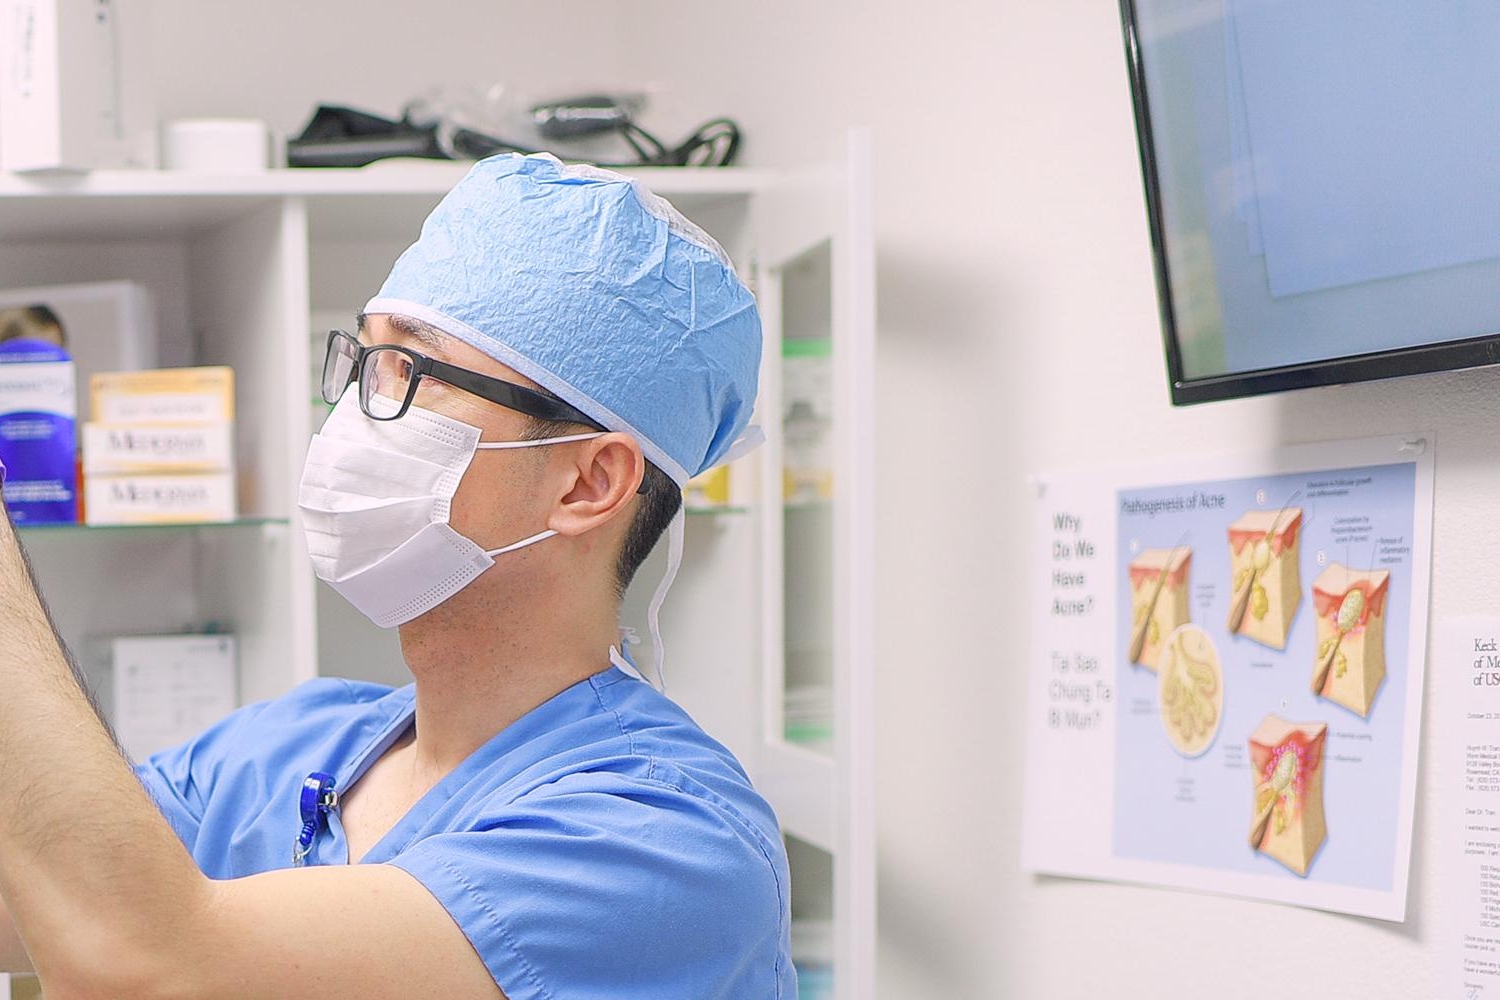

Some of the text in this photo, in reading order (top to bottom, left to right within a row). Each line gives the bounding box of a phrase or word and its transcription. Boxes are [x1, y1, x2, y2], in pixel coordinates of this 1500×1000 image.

[1199, 492, 1226, 509] Acne
[1053, 512, 1081, 533] Why
[1053, 540, 1095, 559] Do We
[1052, 571, 1084, 586] Have
[1474, 638, 1497, 651] Keck
[1473, 655, 1484, 668] of
[1473, 672, 1500, 686] of US
